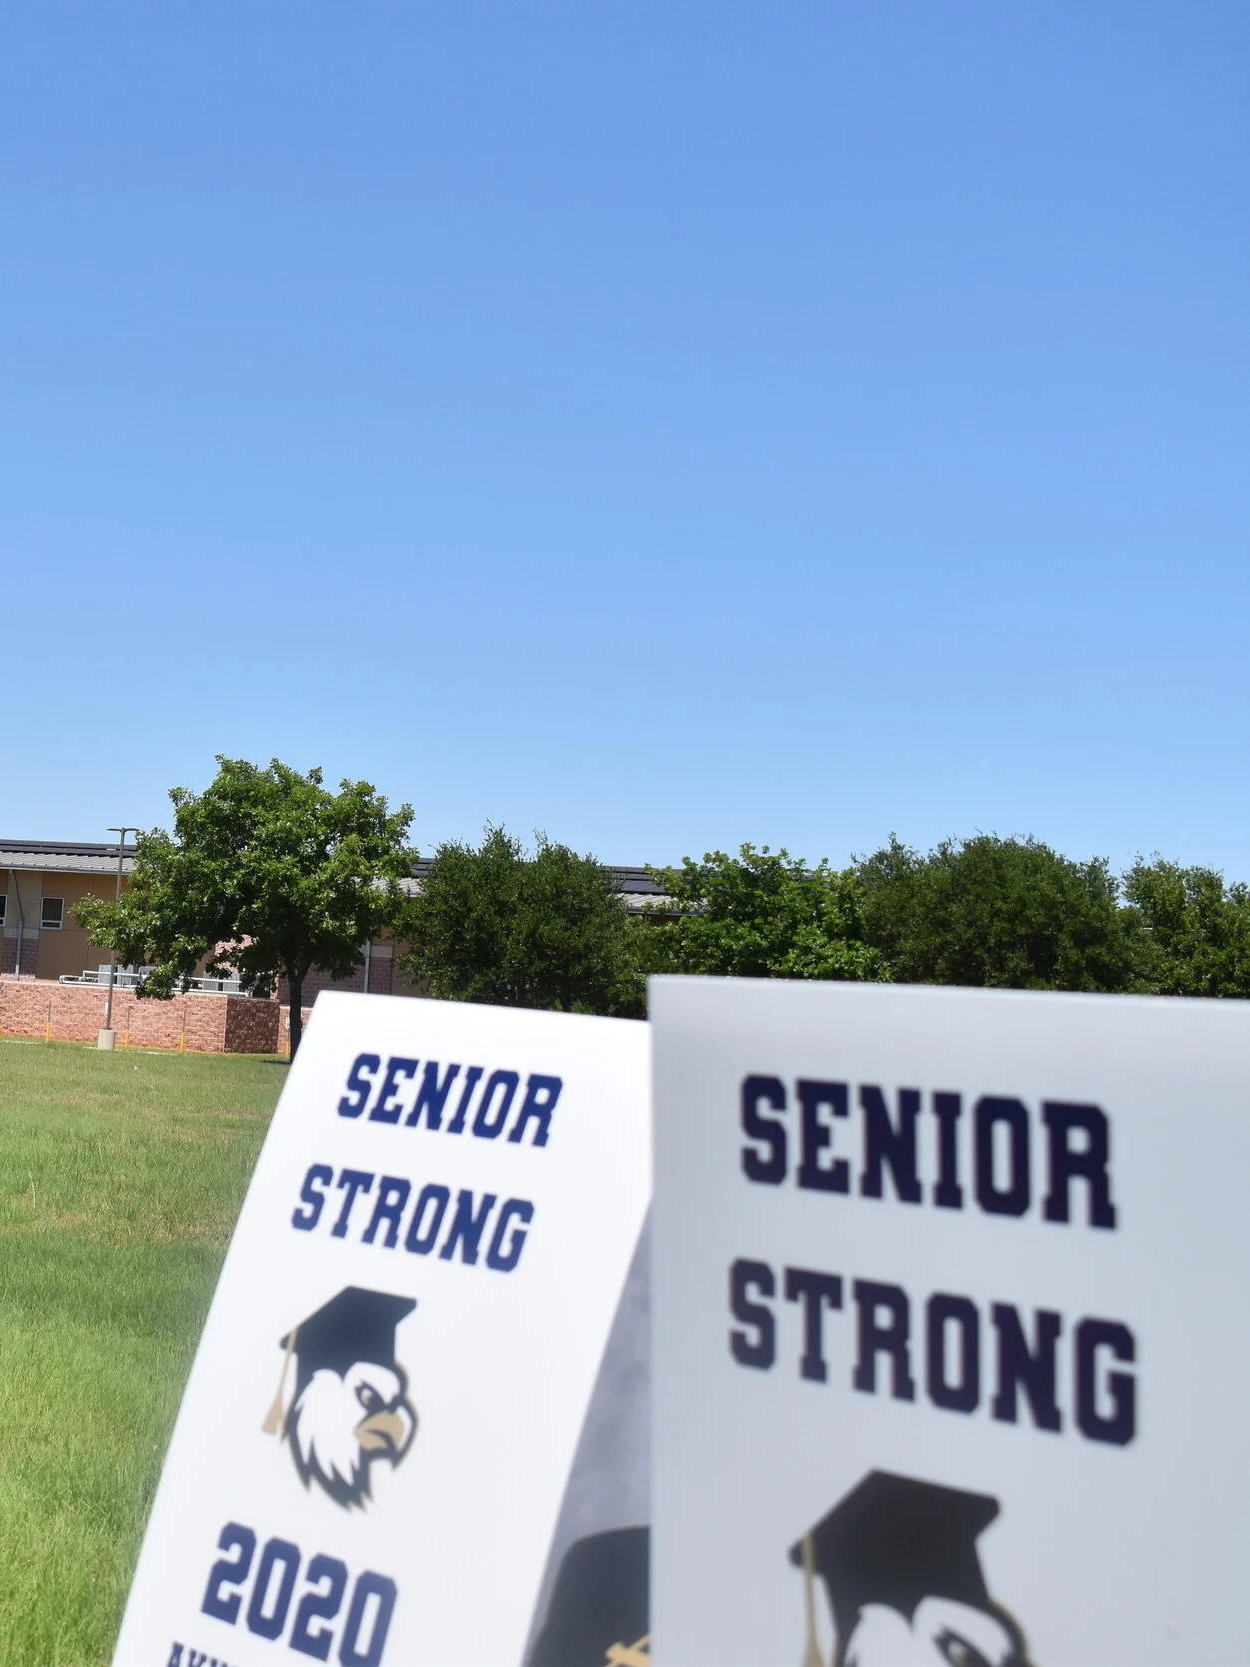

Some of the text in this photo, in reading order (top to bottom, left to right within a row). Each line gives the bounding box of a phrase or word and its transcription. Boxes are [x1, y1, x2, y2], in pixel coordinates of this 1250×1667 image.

[335, 1052, 563, 1149] SENIOR
[739, 1072, 1119, 1233] SENIOR
[291, 1163, 535, 1274] STRONG
[728, 1256, 1139, 1449] STRONG
[200, 1520, 399, 1667] 2020
